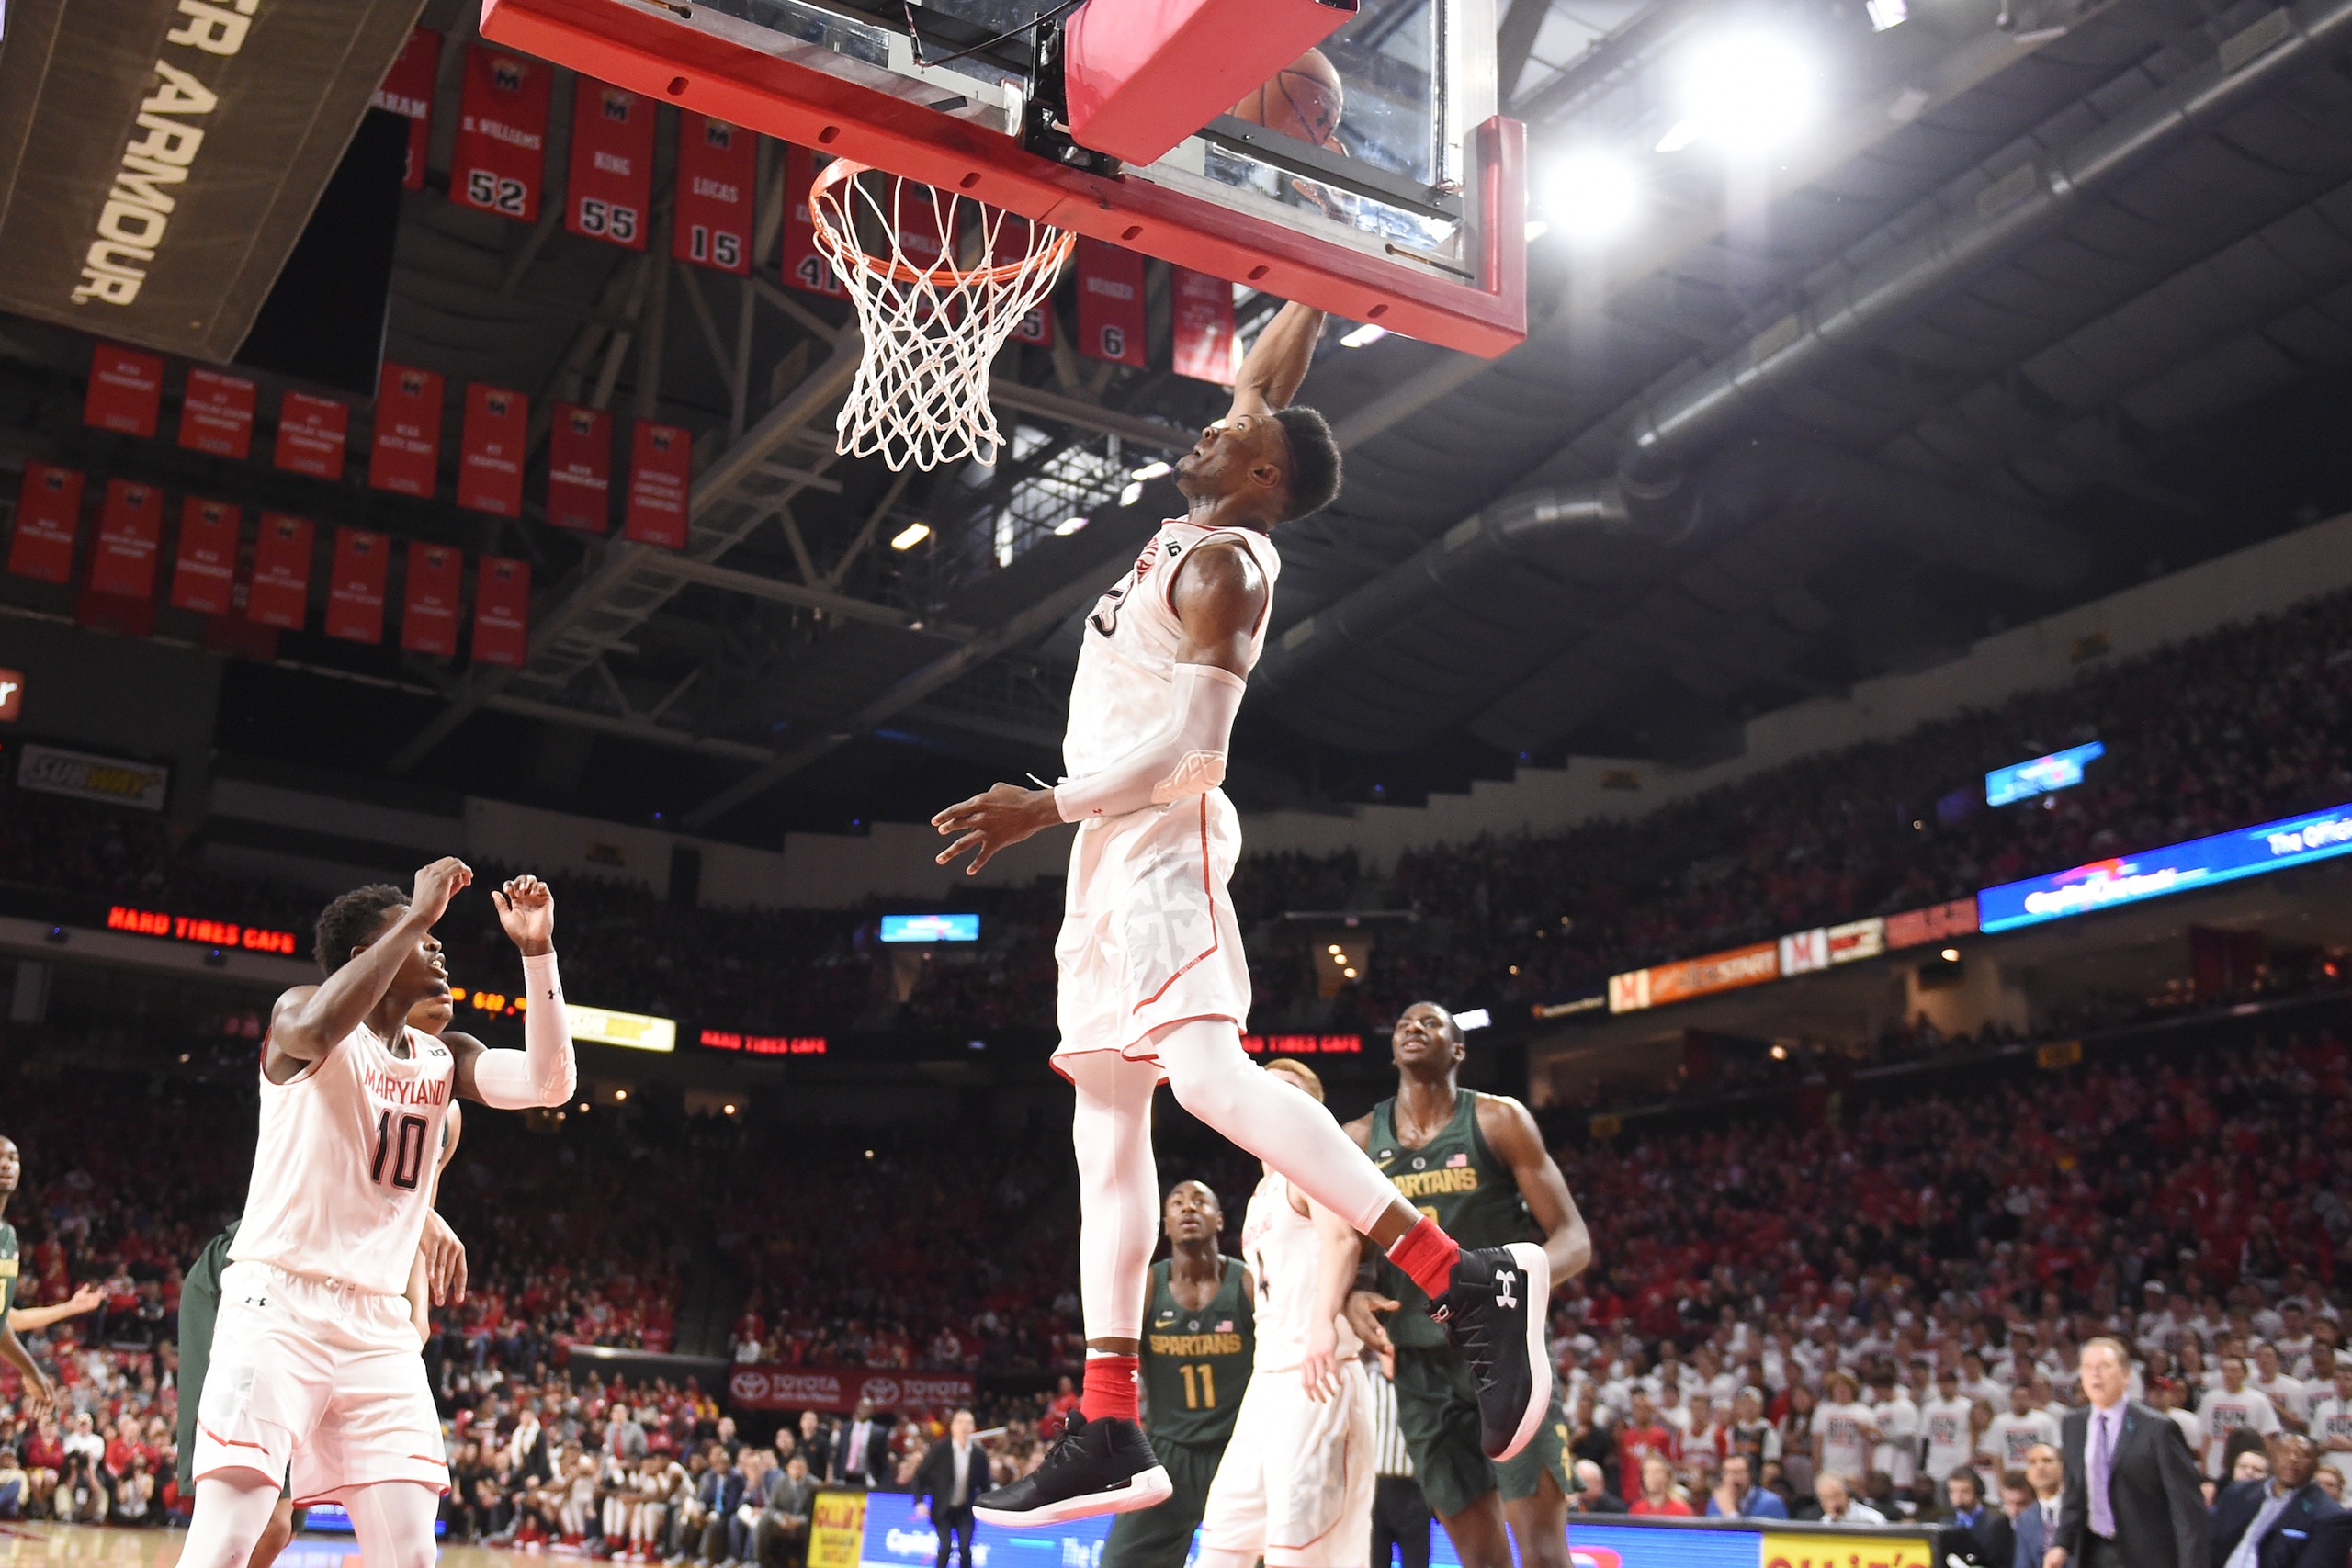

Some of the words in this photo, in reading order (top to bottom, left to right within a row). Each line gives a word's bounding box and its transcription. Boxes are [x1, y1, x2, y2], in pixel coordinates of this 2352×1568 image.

[479, 118, 542, 151] WILLIAMS
[74, 60, 218, 306] ARMOUR
[467, 168, 528, 218] 52
[692, 177, 740, 204] LUCAS
[580, 196, 639, 244] 55
[689, 224, 741, 269] 15
[1100, 323, 1126, 359] 6
[107, 906, 171, 935] HARD
[364, 1064, 446, 1107] MARYLAND
[370, 1108, 429, 1192] 10
[1148, 1333, 1244, 1358] SPARTANS
[772, 1373, 841, 1393] TOYOTA
[903, 1379, 972, 1397] TOYOTA
[1178, 1362, 1217, 1411] 11
